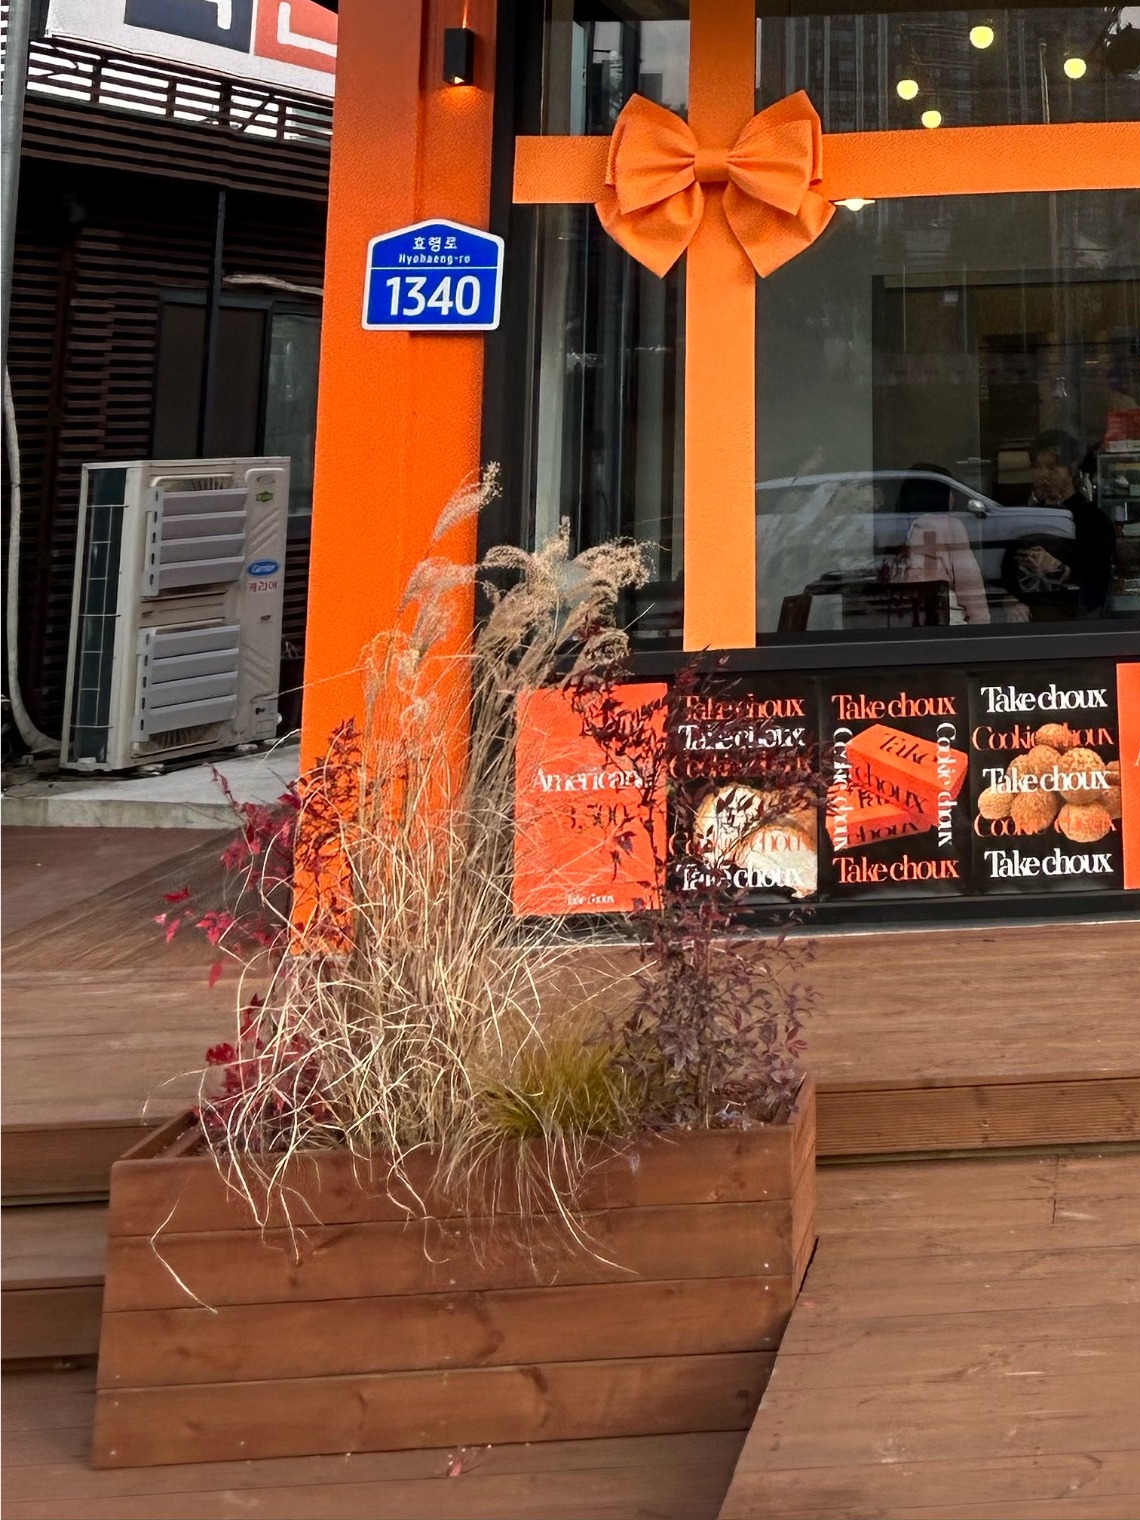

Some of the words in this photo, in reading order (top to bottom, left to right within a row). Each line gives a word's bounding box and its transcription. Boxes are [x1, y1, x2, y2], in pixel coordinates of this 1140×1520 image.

[386, 275, 481, 317] 1340
[832, 694, 886, 720] Take
[888, 692, 957, 718] choux
[981, 686, 1036, 713] Take
[1037, 684, 1109, 710] choux
[1052, 722, 1114, 748] houx
[533, 767, 654, 792] American
[982, 767, 1038, 795] Take
[1040, 765, 1113, 792] choux
[833, 856, 888, 884] Take
[890, 854, 959, 881] choux
[984, 850, 1041, 878] Take
[1042, 848, 1114, 876] choux
